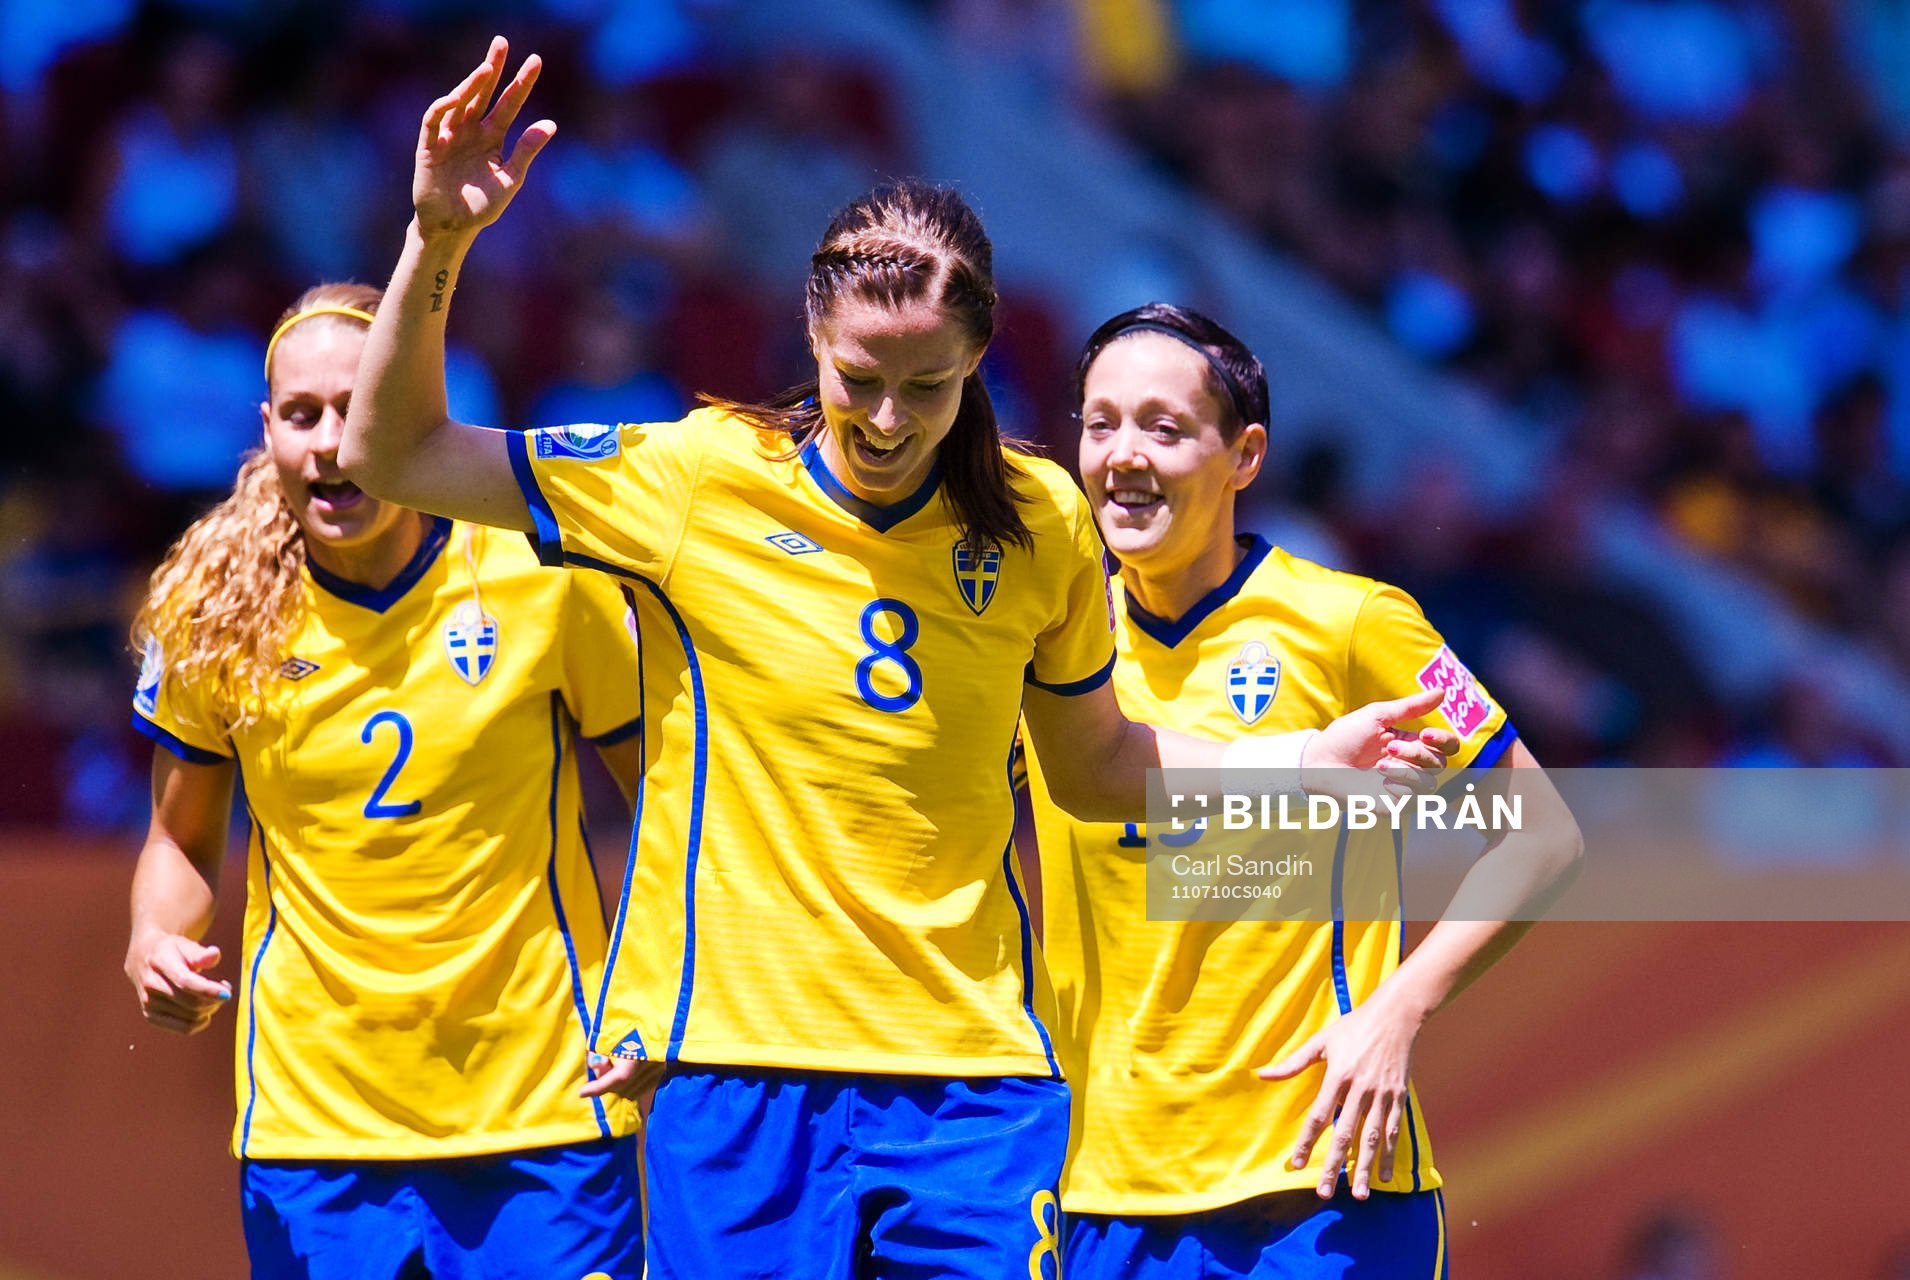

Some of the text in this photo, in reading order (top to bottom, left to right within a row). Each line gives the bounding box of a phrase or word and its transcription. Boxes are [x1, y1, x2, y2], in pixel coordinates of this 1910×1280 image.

[543, 436, 553, 455] FIFA
[855, 597, 922, 712] 8
[361, 710, 422, 818] 2
